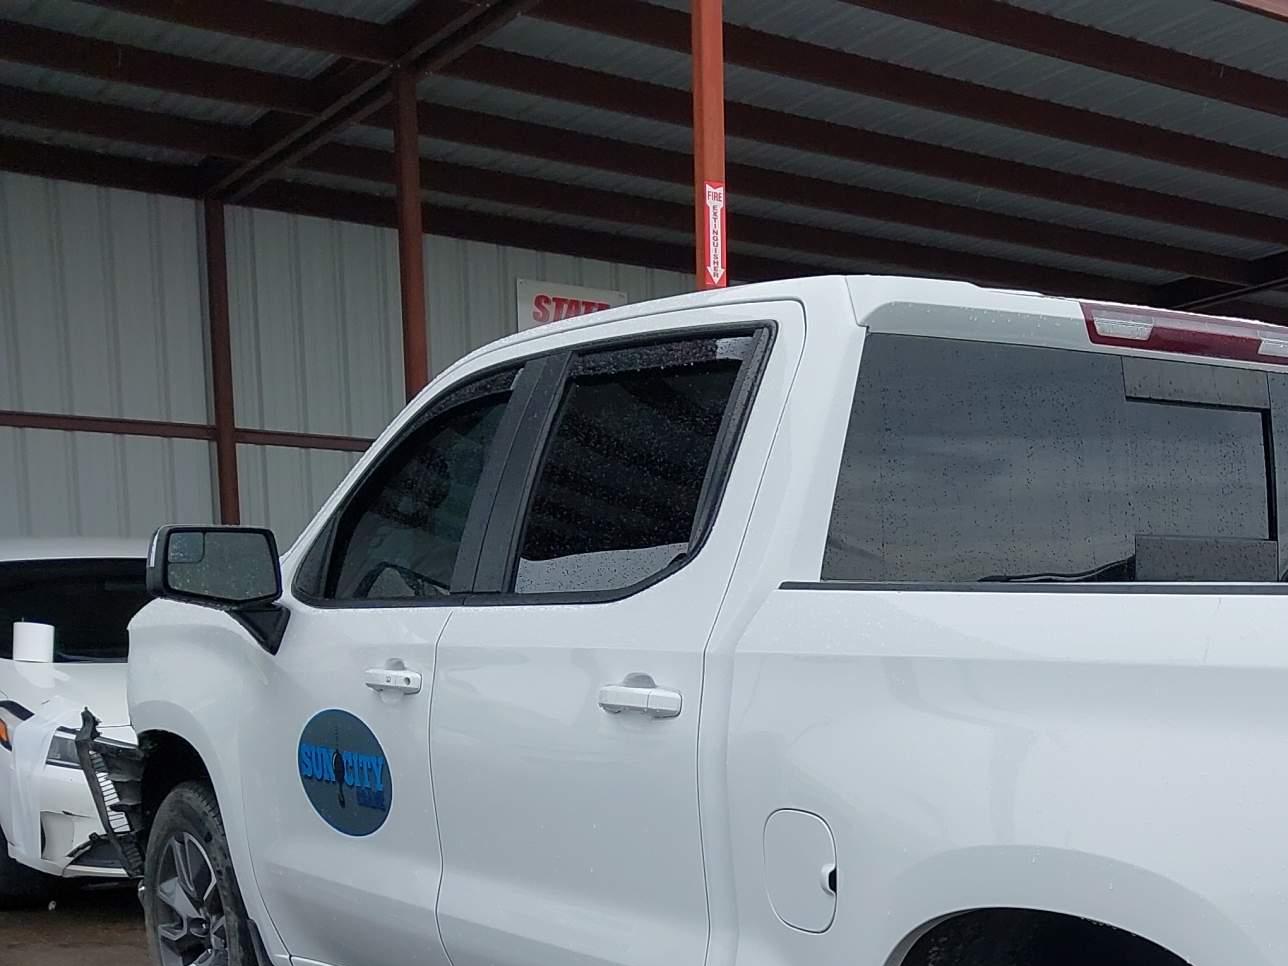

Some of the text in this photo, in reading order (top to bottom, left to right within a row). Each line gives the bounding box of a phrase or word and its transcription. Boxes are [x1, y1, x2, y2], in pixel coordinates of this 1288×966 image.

[707, 190, 722, 201] FIRE
[300, 741, 384, 792] SUN CITY
